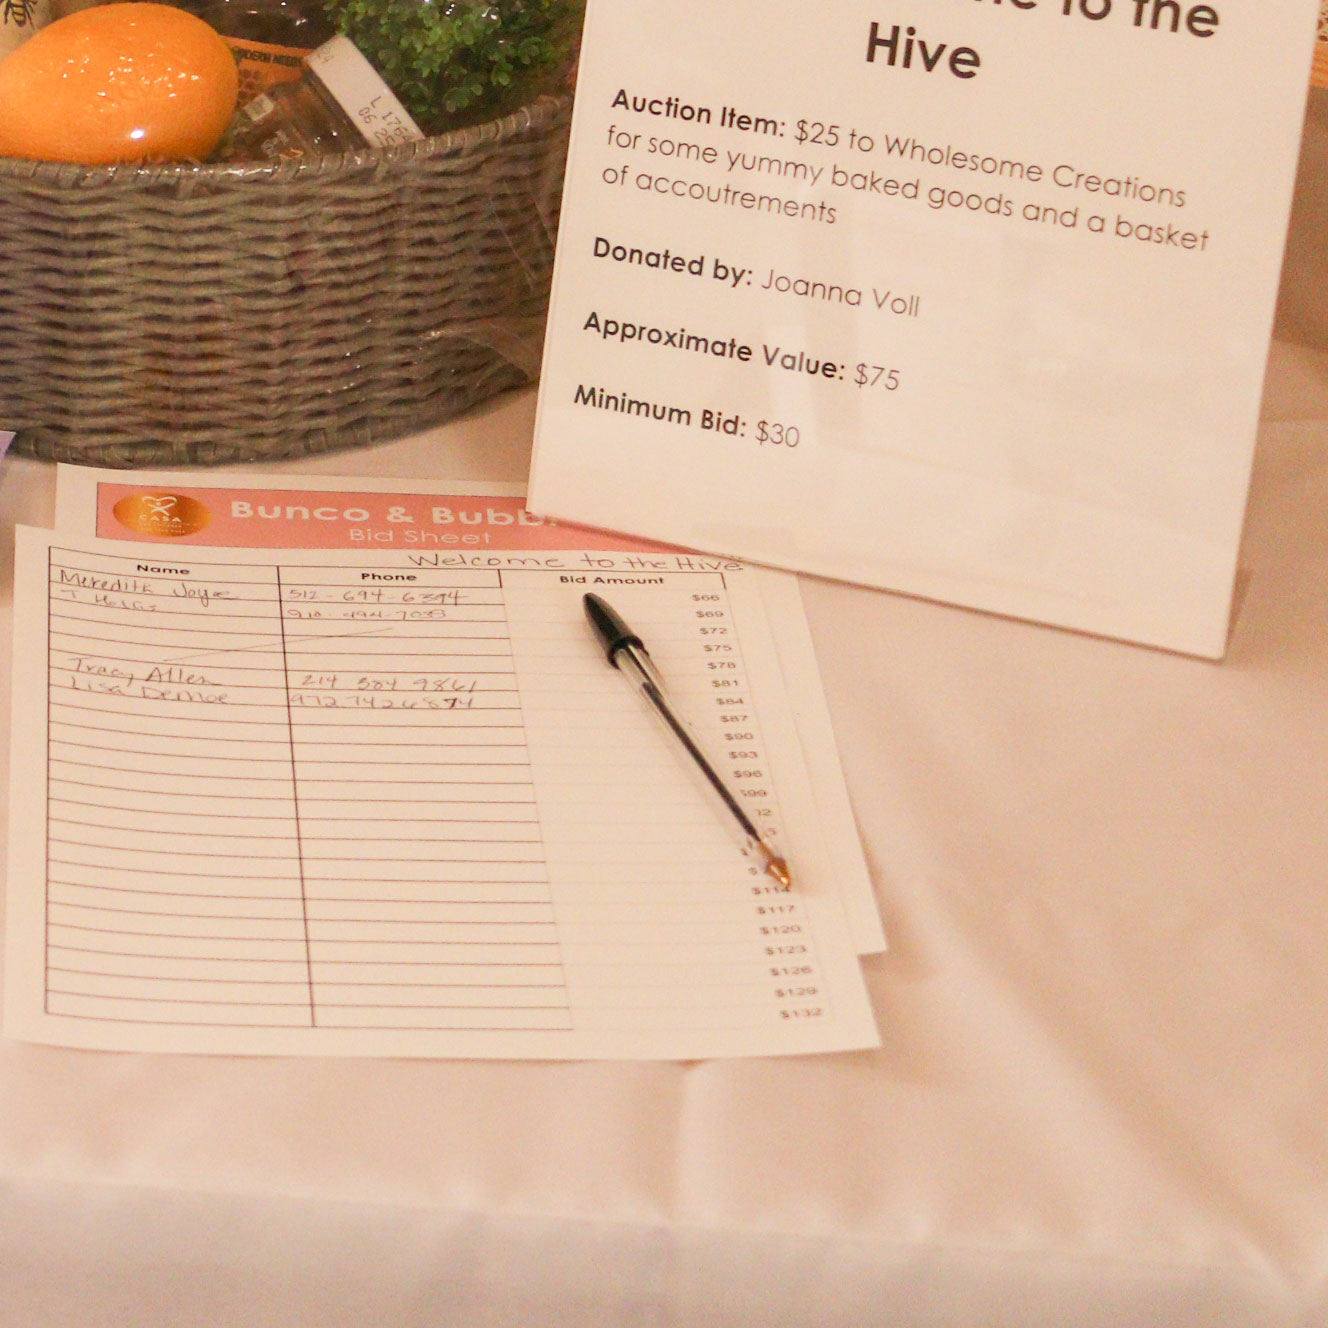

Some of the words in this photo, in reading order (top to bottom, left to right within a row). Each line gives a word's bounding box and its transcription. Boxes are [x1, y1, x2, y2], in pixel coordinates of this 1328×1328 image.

[866, 23, 981, 81] Hive
[612, 89, 711, 126] Auction
[720, 106, 786, 139] Item:
[794, 119, 840, 148] $25
[848, 128, 874, 155] to
[884, 134, 1043, 183] Wholesome
[1052, 163, 1187, 209] Creations
[602, 163, 629, 187] of
[635, 171, 837, 225] accoutrements
[606, 125, 642, 152] for
[648, 137, 717, 164] some
[726, 151, 824, 187] yummy
[832, 164, 920, 200] baked
[928, 182, 1014, 219] goods
[1022, 198, 1078, 229] and
[1087, 213, 1105, 233] a
[1114, 215, 1210, 252] basket
[593, 237, 704, 277] Donated
[712, 254, 753, 287] by:
[761, 268, 863, 307] Joanna
[872, 289, 920, 318] Voll
[582, 311, 753, 362] Approximate
[762, 344, 846, 381] Value:
[854, 363, 900, 393] $75
[573, 384, 692, 427] Minimum
[701, 409, 747, 438] Bid:
[755, 419, 800, 450] $30
[231, 501, 369, 522] Bunco
[386, 506, 414, 524] &
[349, 528, 393, 542] Bid
[403, 529, 492, 544] Sheet
[137, 564, 190, 575] Name
[361, 573, 417, 582] Phone
[560, 575, 585, 584] Bid
[592, 576, 665, 585] Amount
[408, 553, 564, 568] Welcome
[581, 553, 615, 569] to
